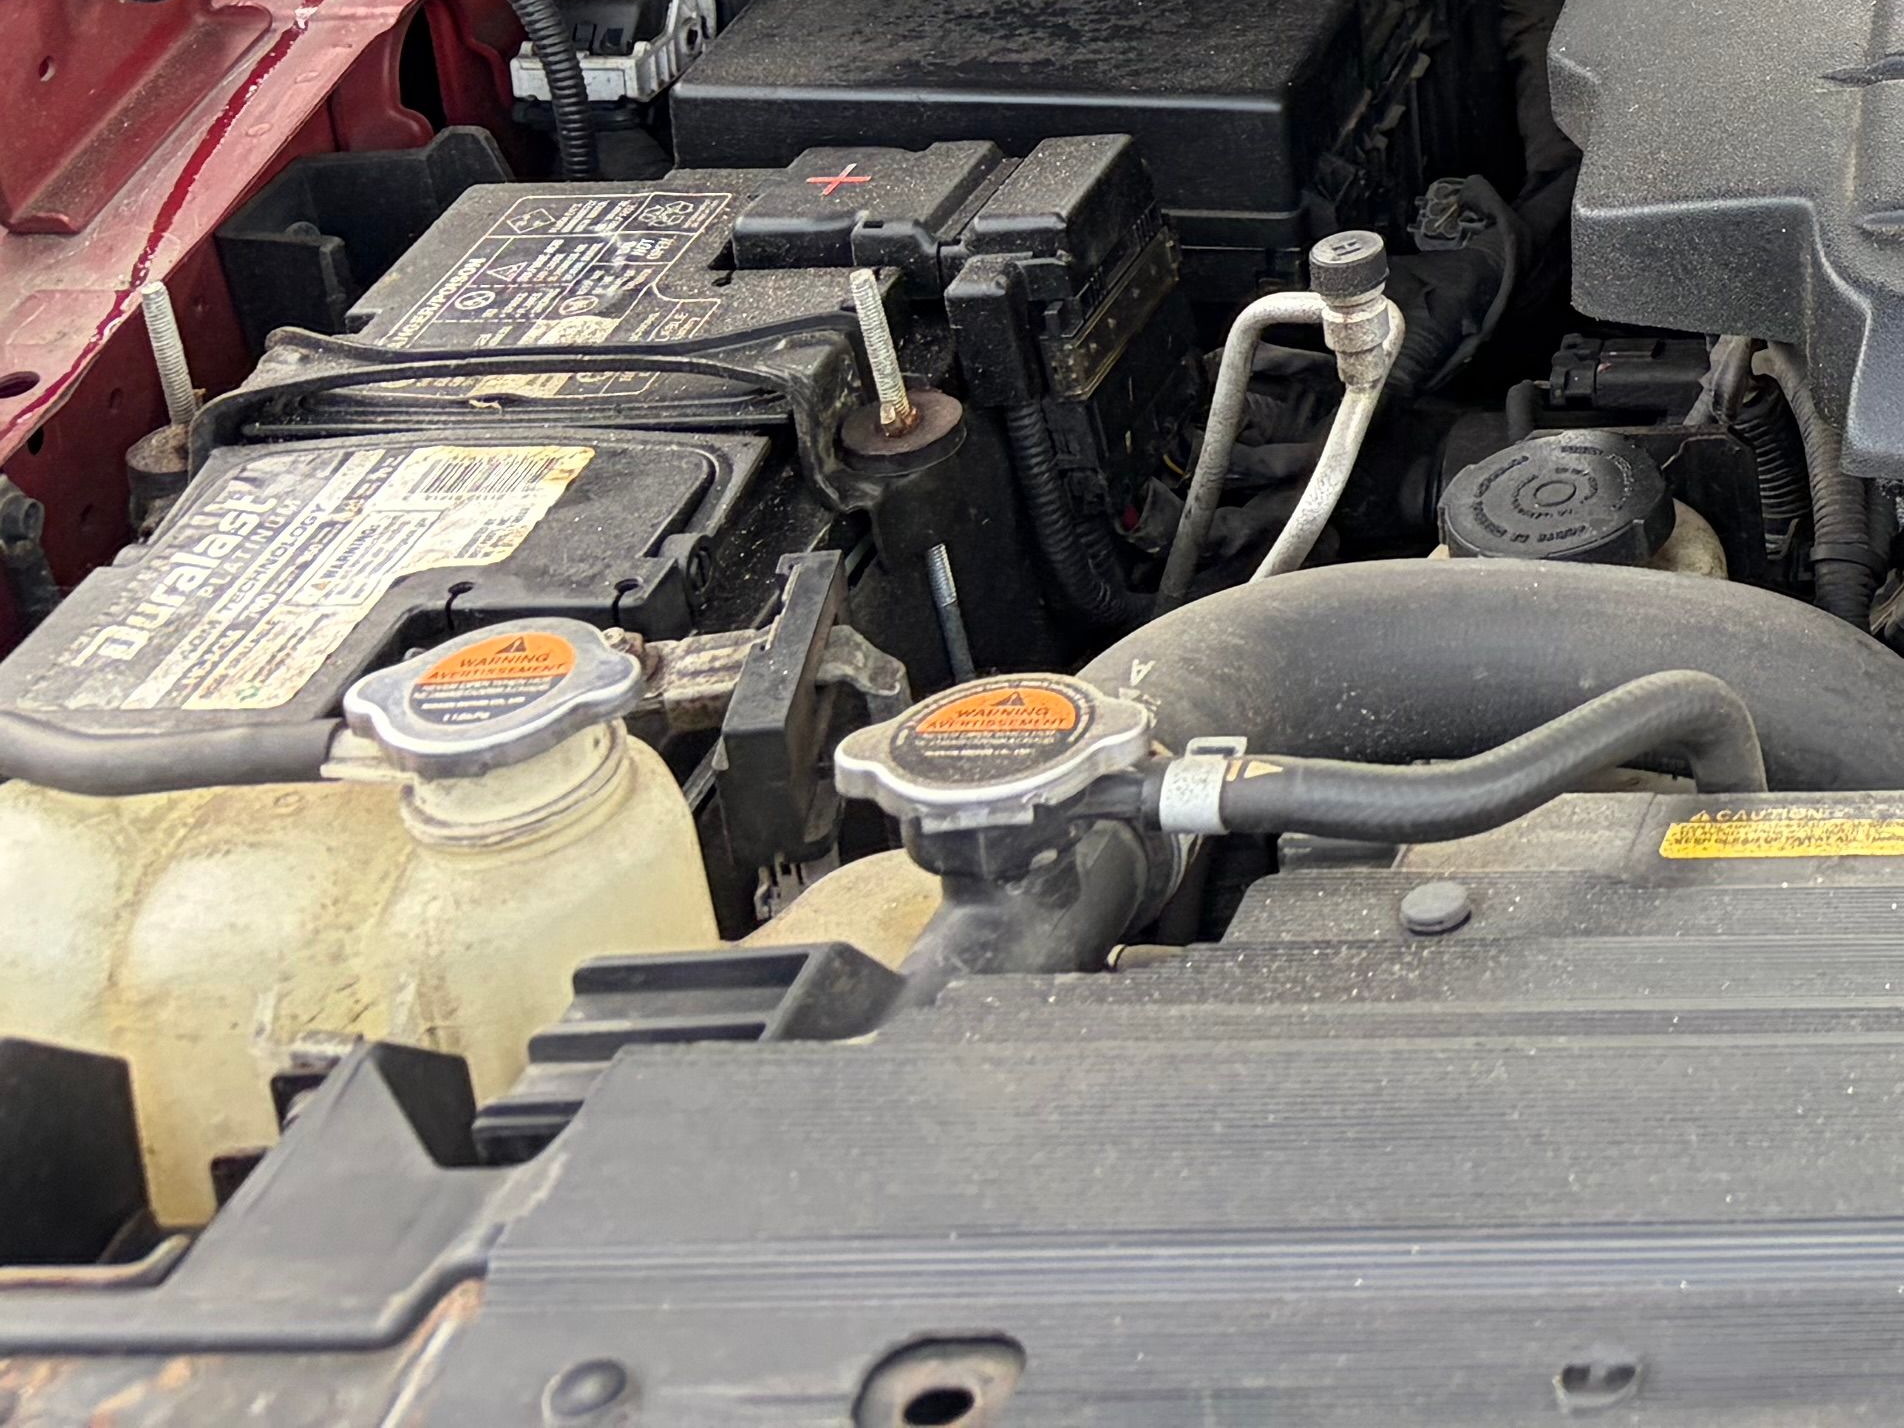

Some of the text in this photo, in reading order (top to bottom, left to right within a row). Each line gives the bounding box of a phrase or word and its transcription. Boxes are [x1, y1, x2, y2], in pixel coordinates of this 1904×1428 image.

[198, 498, 301, 597] PLATINUM
[225, 503, 327, 618] TECHNOLOGY
[70, 492, 277, 667] Duralast
[459, 653, 550, 667] WARNING
[956, 706, 1051, 718] WARNING
[1715, 806, 1824, 822] CAUTION
